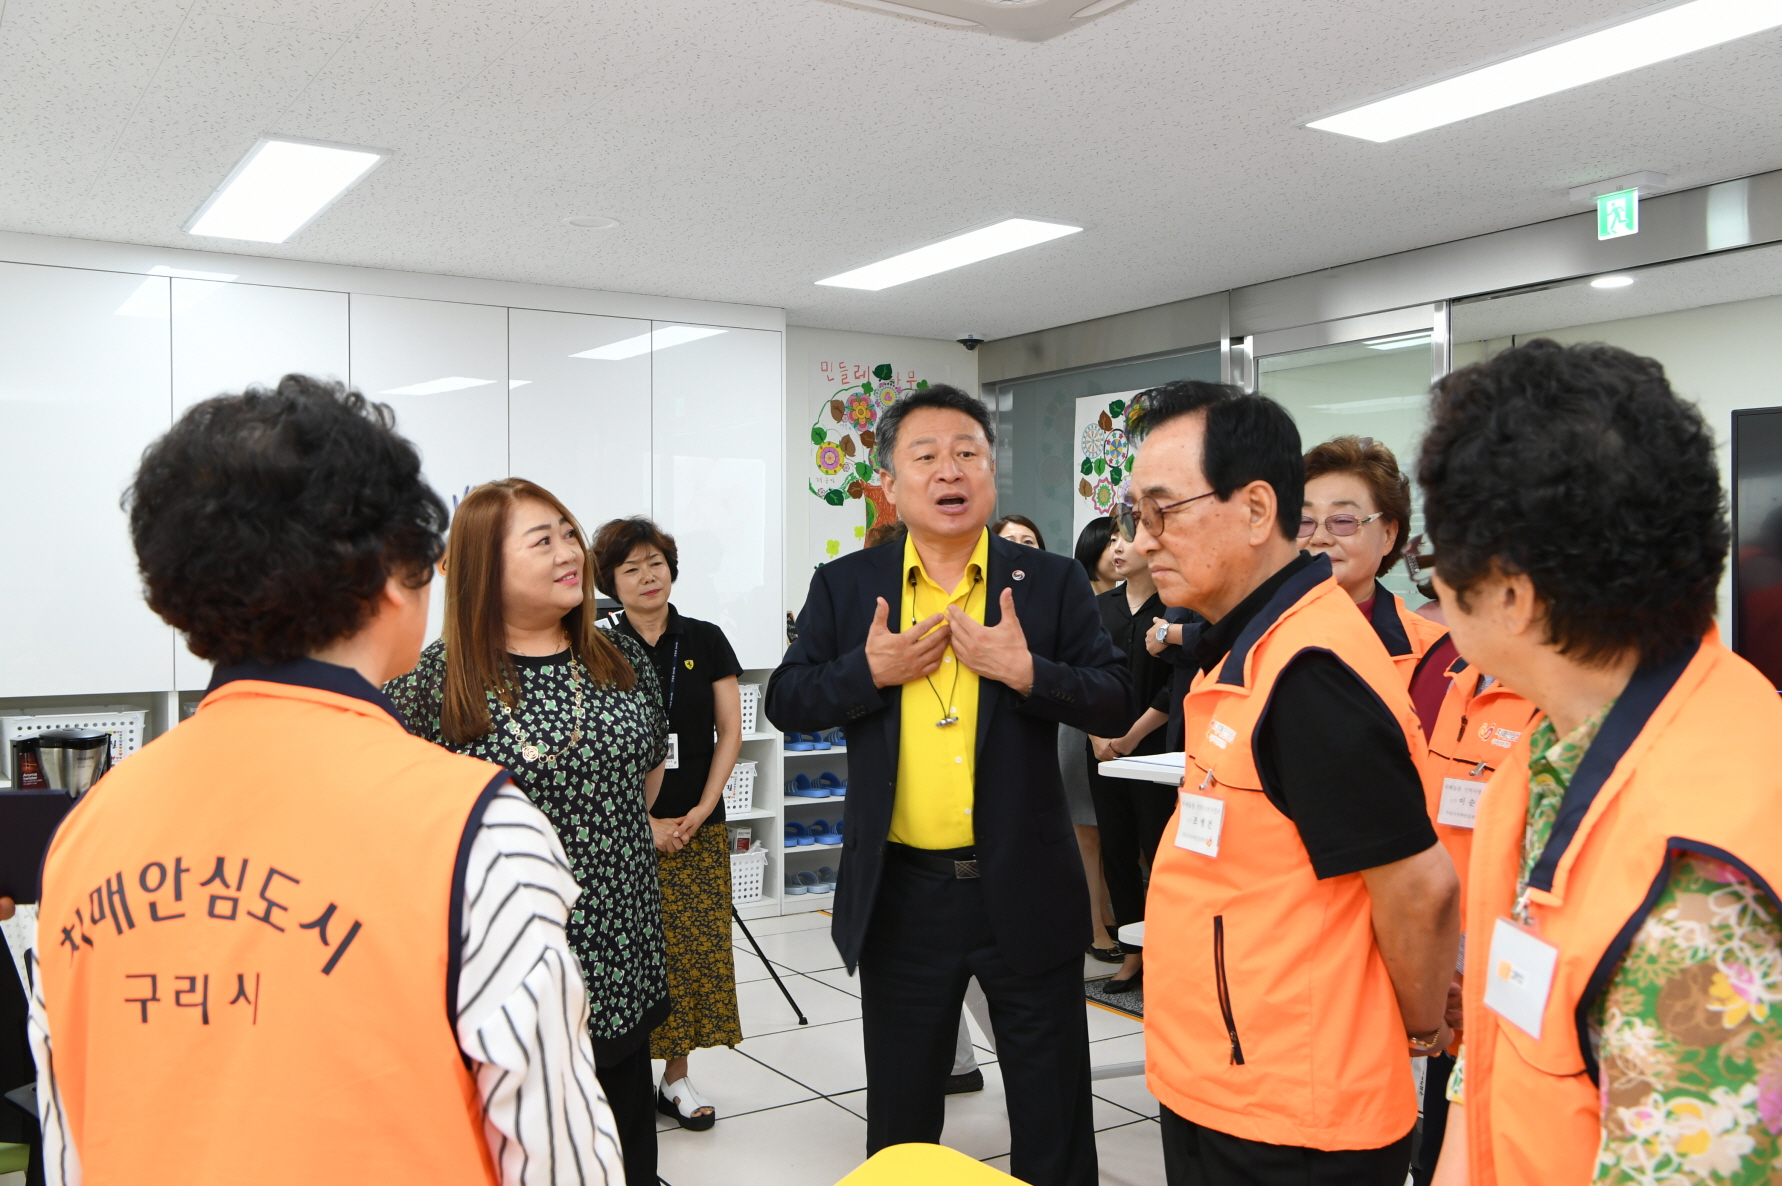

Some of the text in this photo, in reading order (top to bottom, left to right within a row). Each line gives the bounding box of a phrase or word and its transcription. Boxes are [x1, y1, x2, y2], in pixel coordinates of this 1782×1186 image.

[820, 361, 870, 385] 민들레
[59, 856, 363, 977] 치매안심도시
[123, 972, 261, 1026] 구리시
